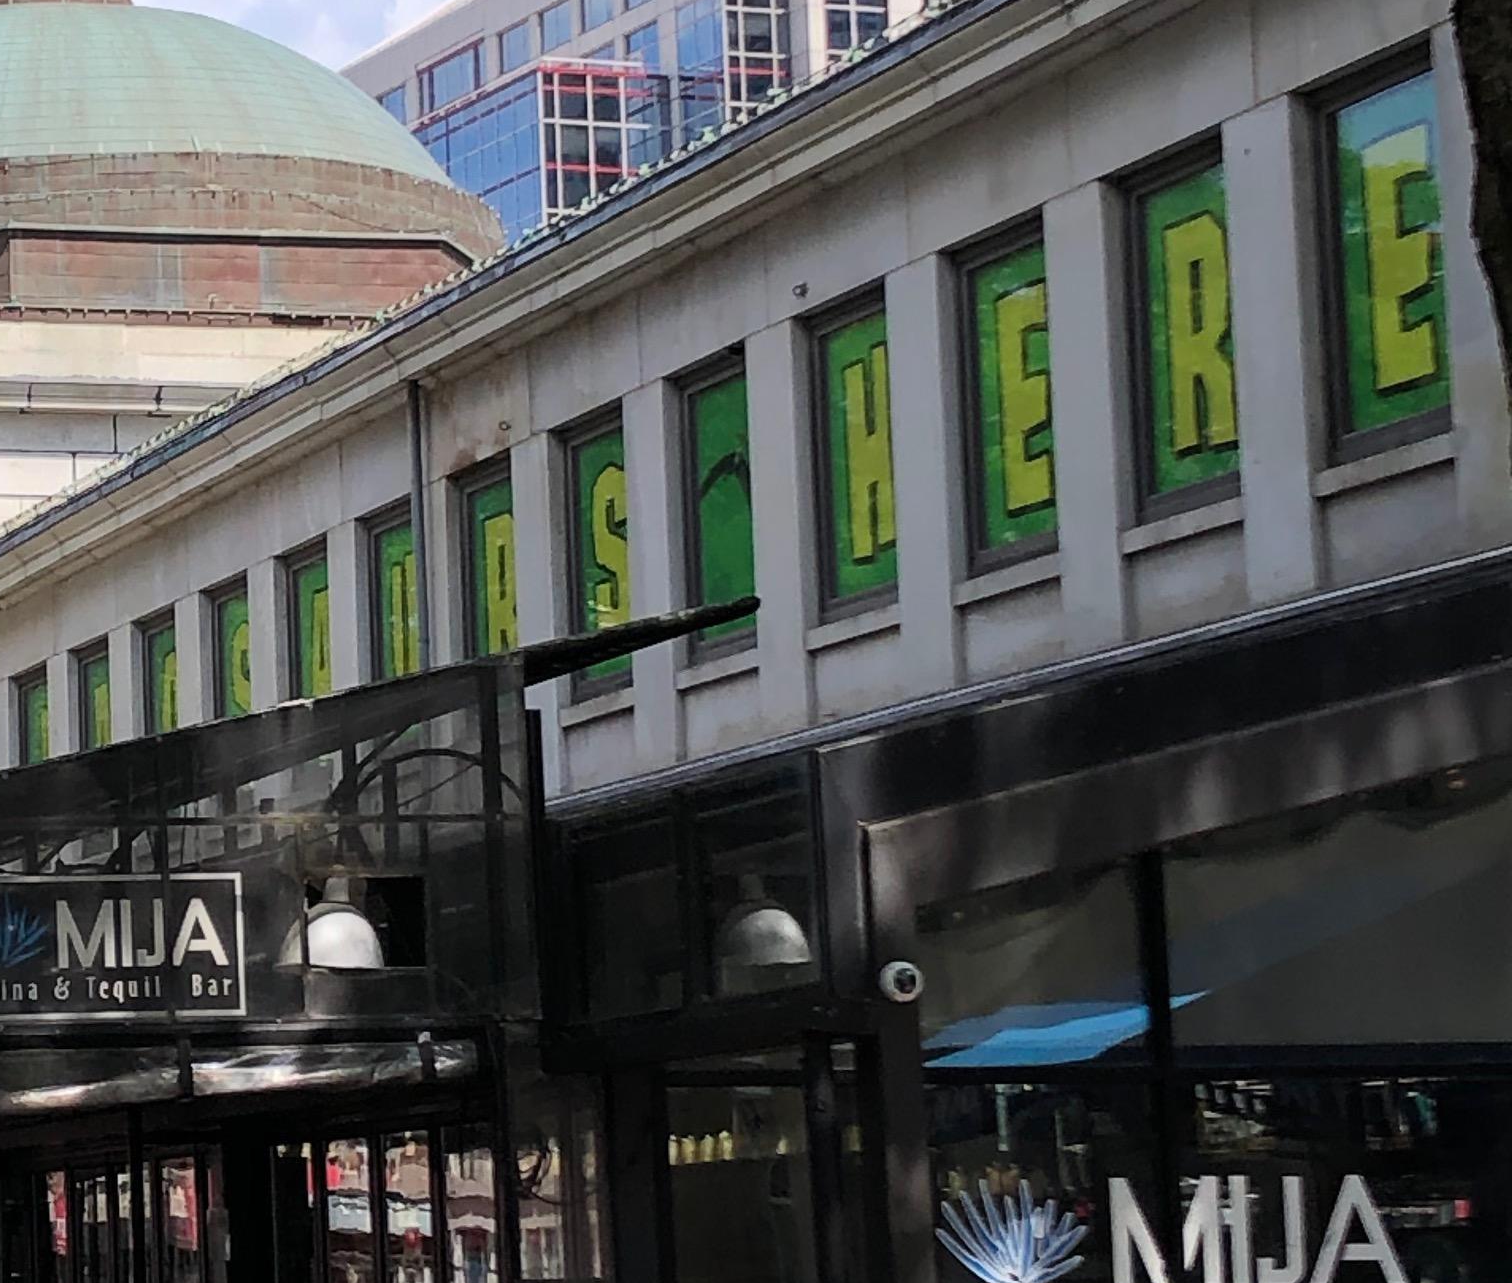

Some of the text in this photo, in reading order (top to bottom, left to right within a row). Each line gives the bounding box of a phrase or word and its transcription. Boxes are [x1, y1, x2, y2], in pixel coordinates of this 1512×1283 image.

[843, 123, 1437, 564] HERE
[55, 897, 230, 969] MIJA
[53, 975, 71, 1001] &
[86, 975, 163, 1004] Tequil
[191, 973, 233, 998] Bar
